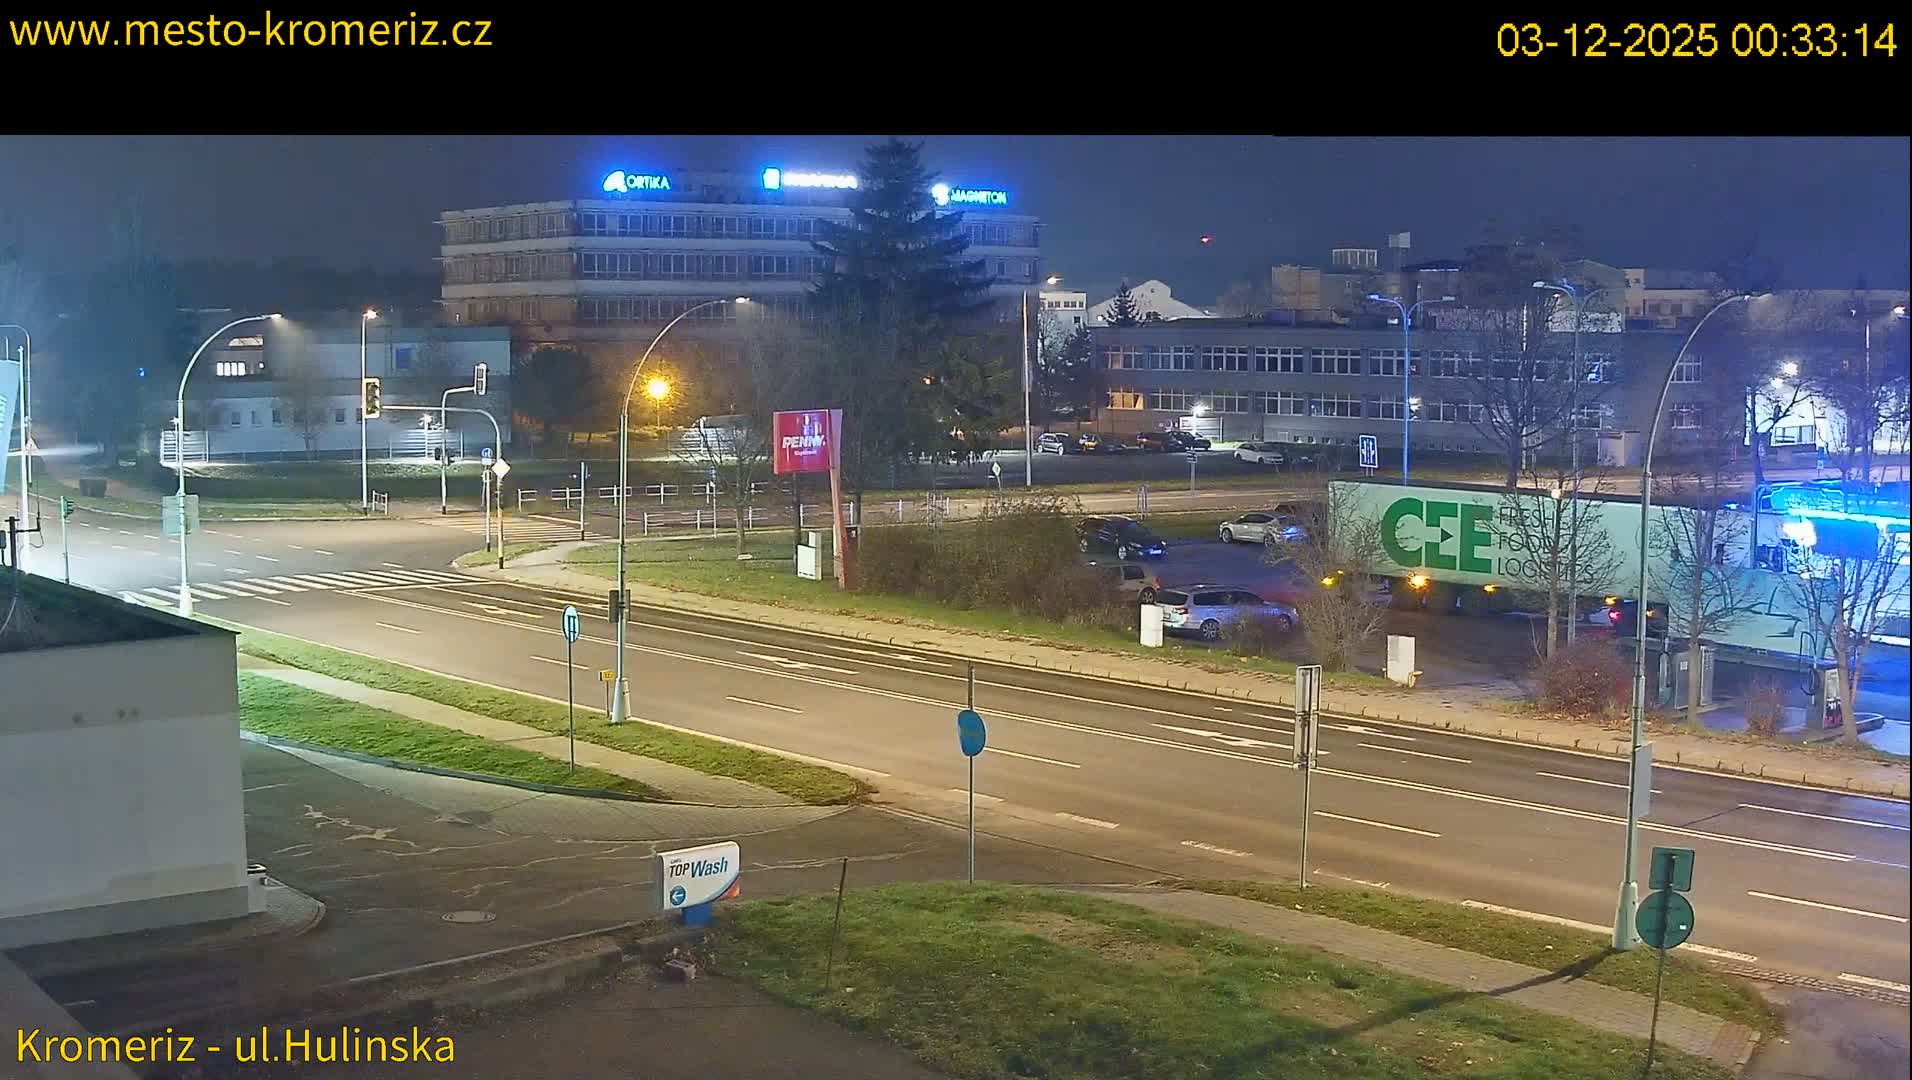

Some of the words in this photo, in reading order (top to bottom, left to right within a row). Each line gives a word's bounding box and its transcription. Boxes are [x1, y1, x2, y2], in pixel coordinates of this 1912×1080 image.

[626, 174, 671, 190] ORTIKA
[1499, 506, 1556, 529] FRESH
[1498, 532, 1557, 554] FOOD
[669, 863, 690, 878] TOP
